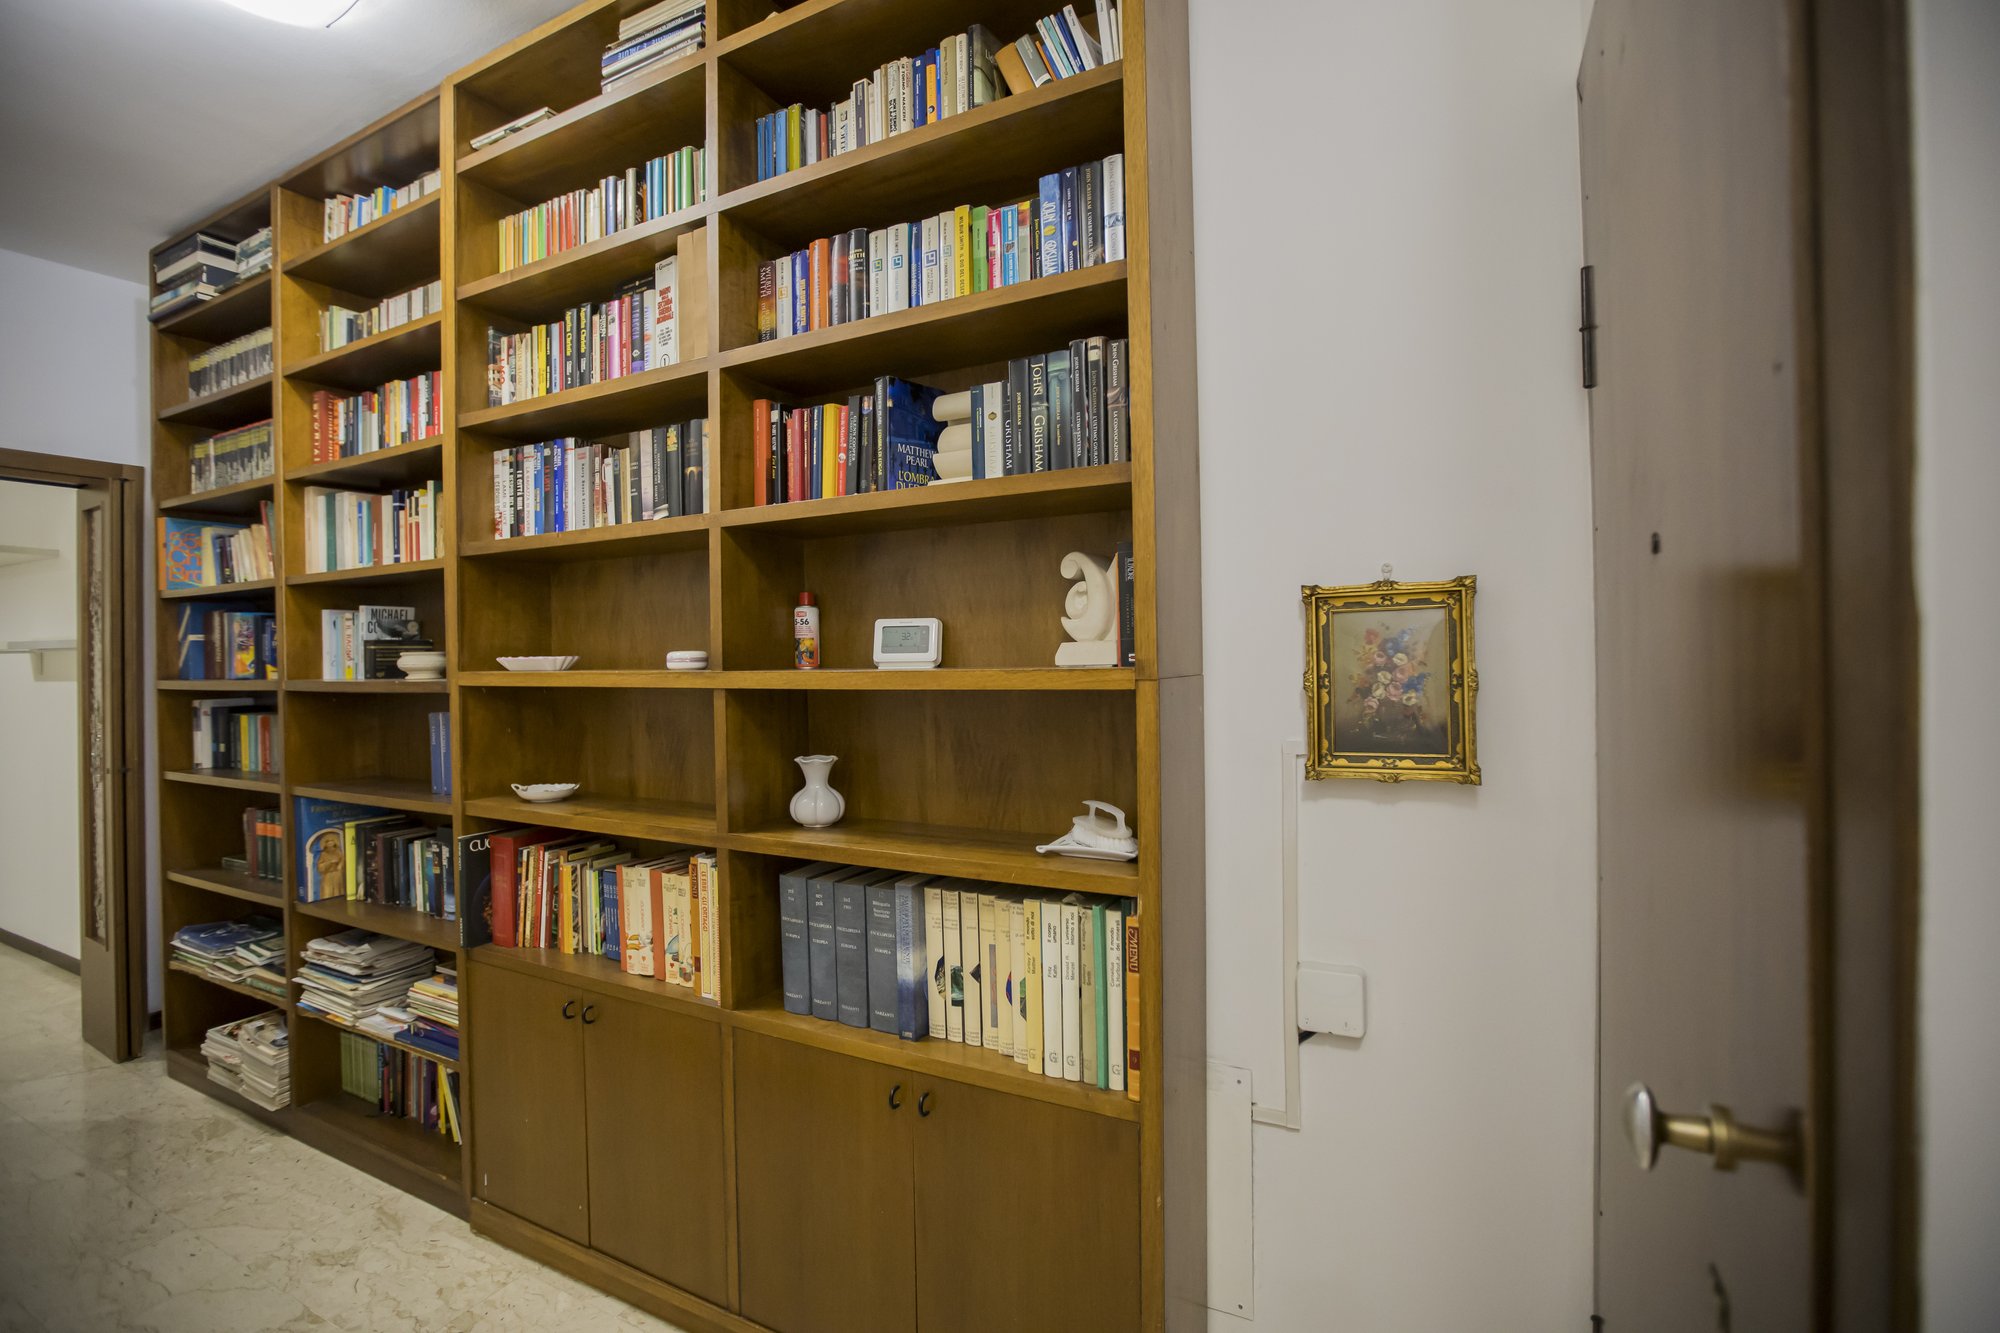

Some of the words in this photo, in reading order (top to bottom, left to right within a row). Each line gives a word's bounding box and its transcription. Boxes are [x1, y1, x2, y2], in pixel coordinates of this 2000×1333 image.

[1042, 201, 1056, 223] JOHN
[1043, 239, 1058, 276] GRISHAM
[1030, 362, 1044, 396] JOHN
[897, 443, 936, 459] MATTHEW
[1005, 419, 1013, 468] GRISHAM
[1034, 415, 1046, 472] GRISHAM
[905, 455, 929, 469] PEARL
[870, 930, 896, 938] ENCICLOPEDIA
[874, 947, 892, 955] EUROPEA
[1128, 928, 1139, 971] MENU
[875, 1010, 895, 1018] GARZANTI
